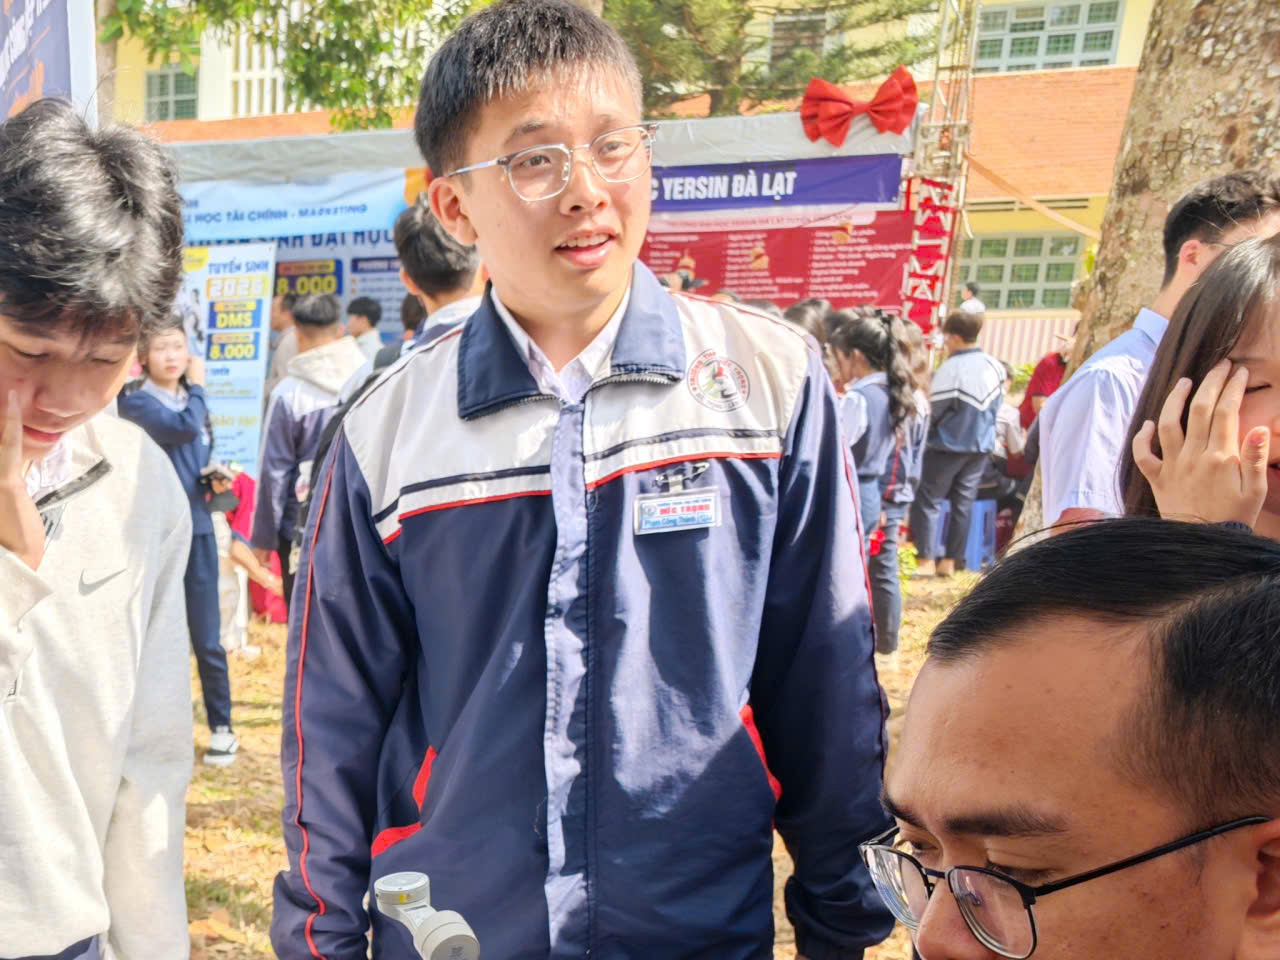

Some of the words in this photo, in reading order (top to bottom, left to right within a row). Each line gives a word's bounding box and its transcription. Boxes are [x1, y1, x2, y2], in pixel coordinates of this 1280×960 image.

[663, 177, 729, 200] YERSIN
[731, 170, 758, 197] ĐÀ
[761, 171, 798, 200] LẠT
[195, 212, 221, 224] HỌC
[210, 277, 265, 298] 2026
[210, 343, 255, 360] 8.000
